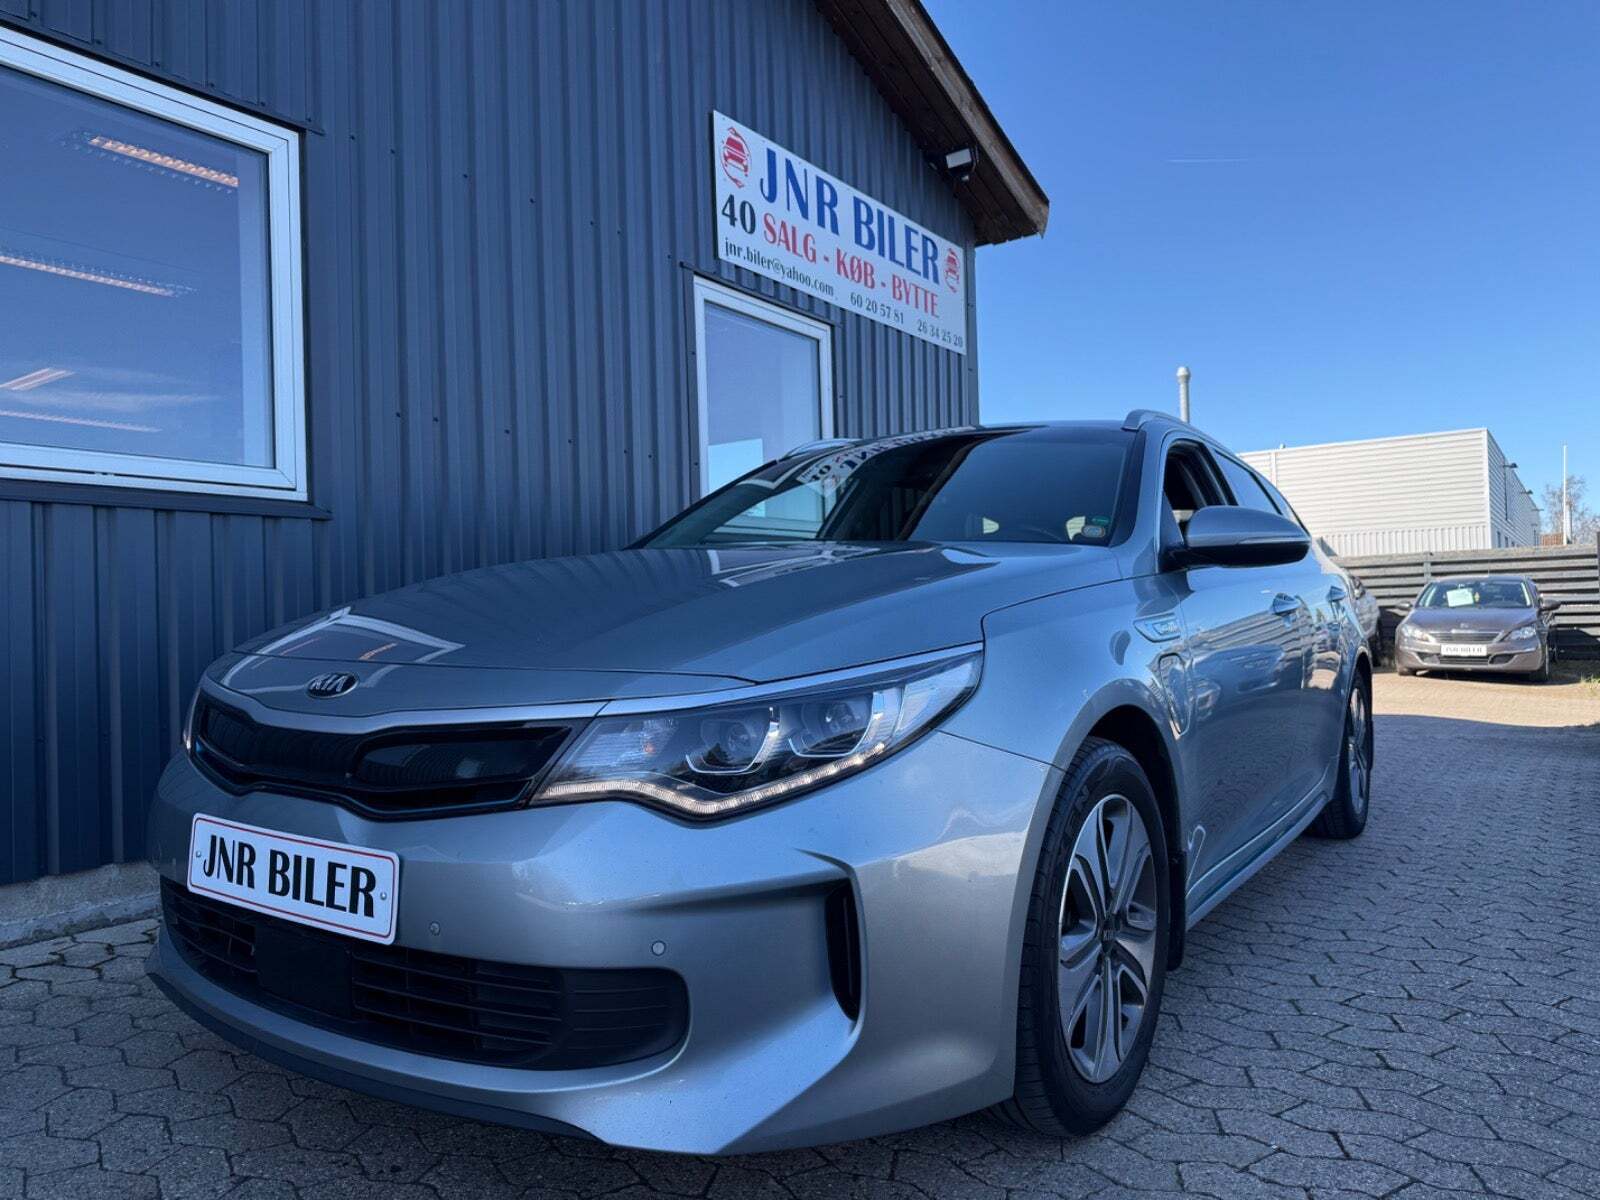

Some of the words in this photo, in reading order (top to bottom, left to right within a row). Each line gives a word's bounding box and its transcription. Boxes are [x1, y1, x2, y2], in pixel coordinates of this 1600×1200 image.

[721, 194, 756, 235] 40
[760, 147, 839, 236] JNR
[853, 196, 940, 286] BILER
[725, 237, 834, 297] jnr.biler@yahoo.com
[763, 212, 817, 264] SALG
[836, 247, 876, 290] KØB
[892, 274, 940, 318] BYTTE
[850, 292, 863, 308] 60
[865, 297, 877, 314] 20
[880, 303, 891, 319] 57
[893, 309, 904, 324] 81
[203, 834, 256, 889] JNR
[268, 849, 377, 918] BILER
